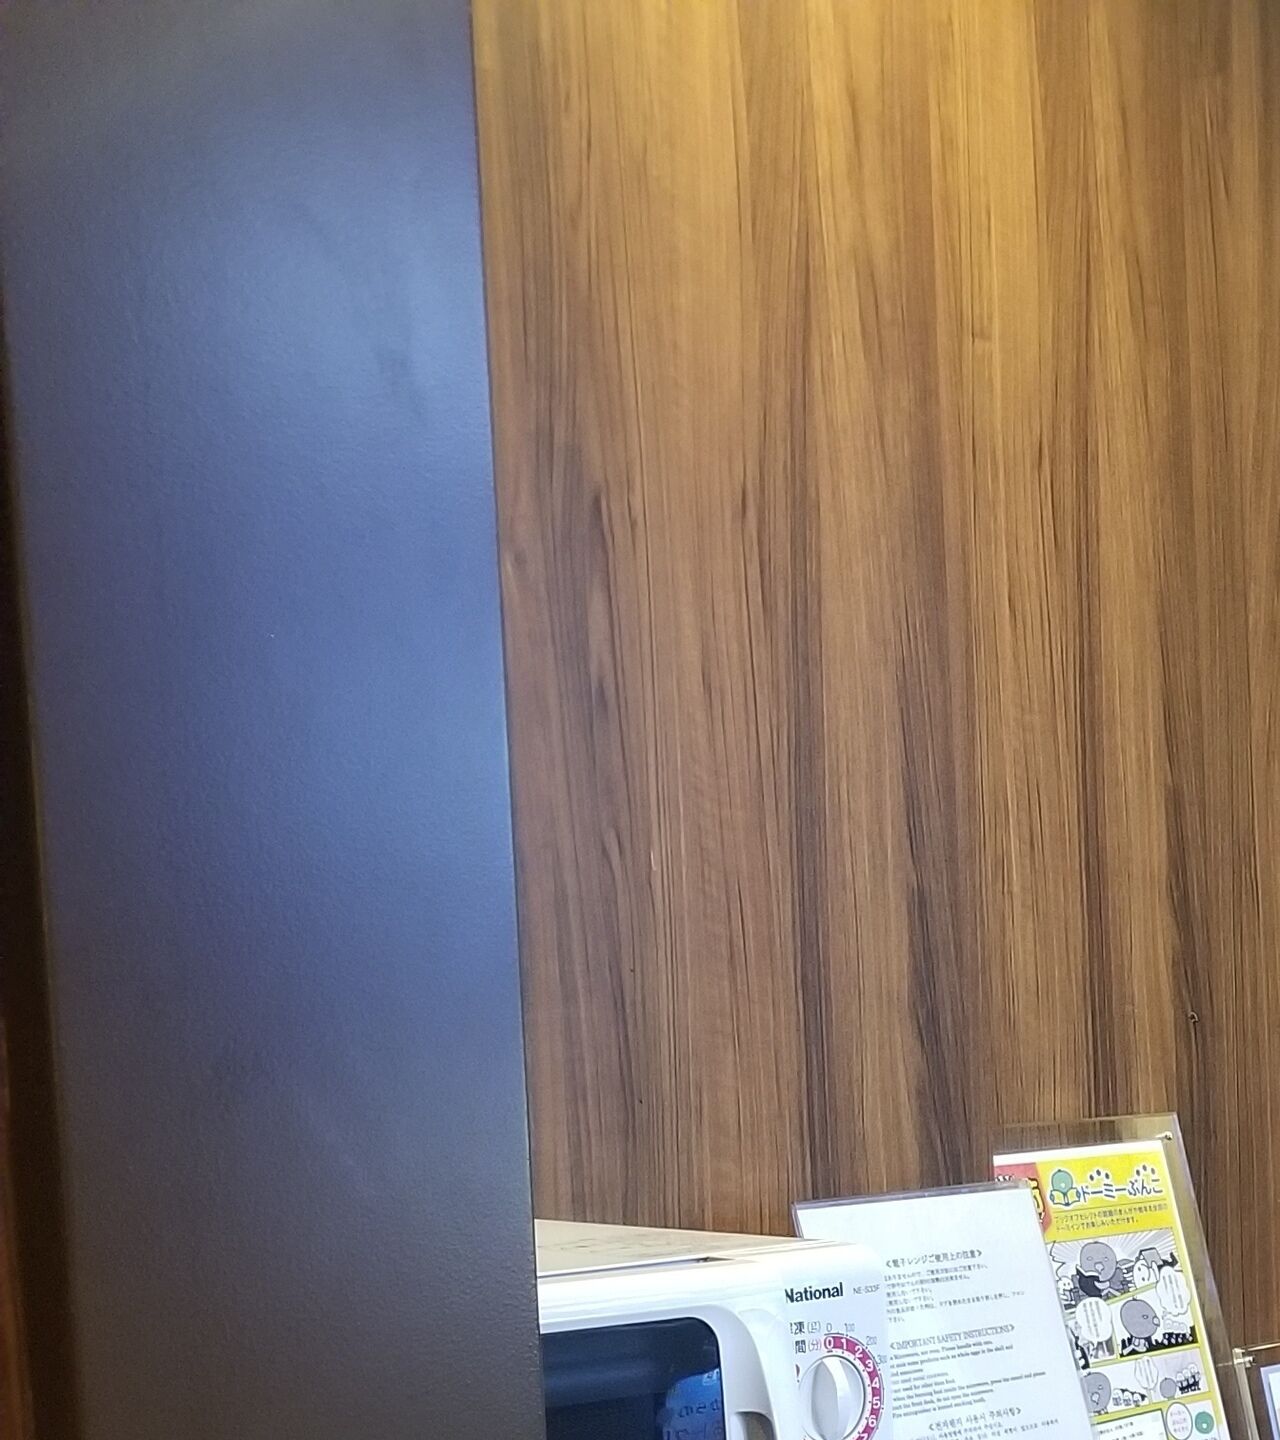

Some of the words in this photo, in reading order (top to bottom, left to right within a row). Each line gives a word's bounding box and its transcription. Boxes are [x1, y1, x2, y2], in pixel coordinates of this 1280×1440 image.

[784, 1282, 843, 1303] National
[826, 1337, 834, 1349] 0
[841, 1338, 847, 1349] 1
[855, 1346, 863, 1357] 2
[865, 1359, 874, 1372] 3
[871, 1377, 880, 1388] 4
[872, 1396, 880, 1409] 5
[868, 1415, 876, 1427] 6
